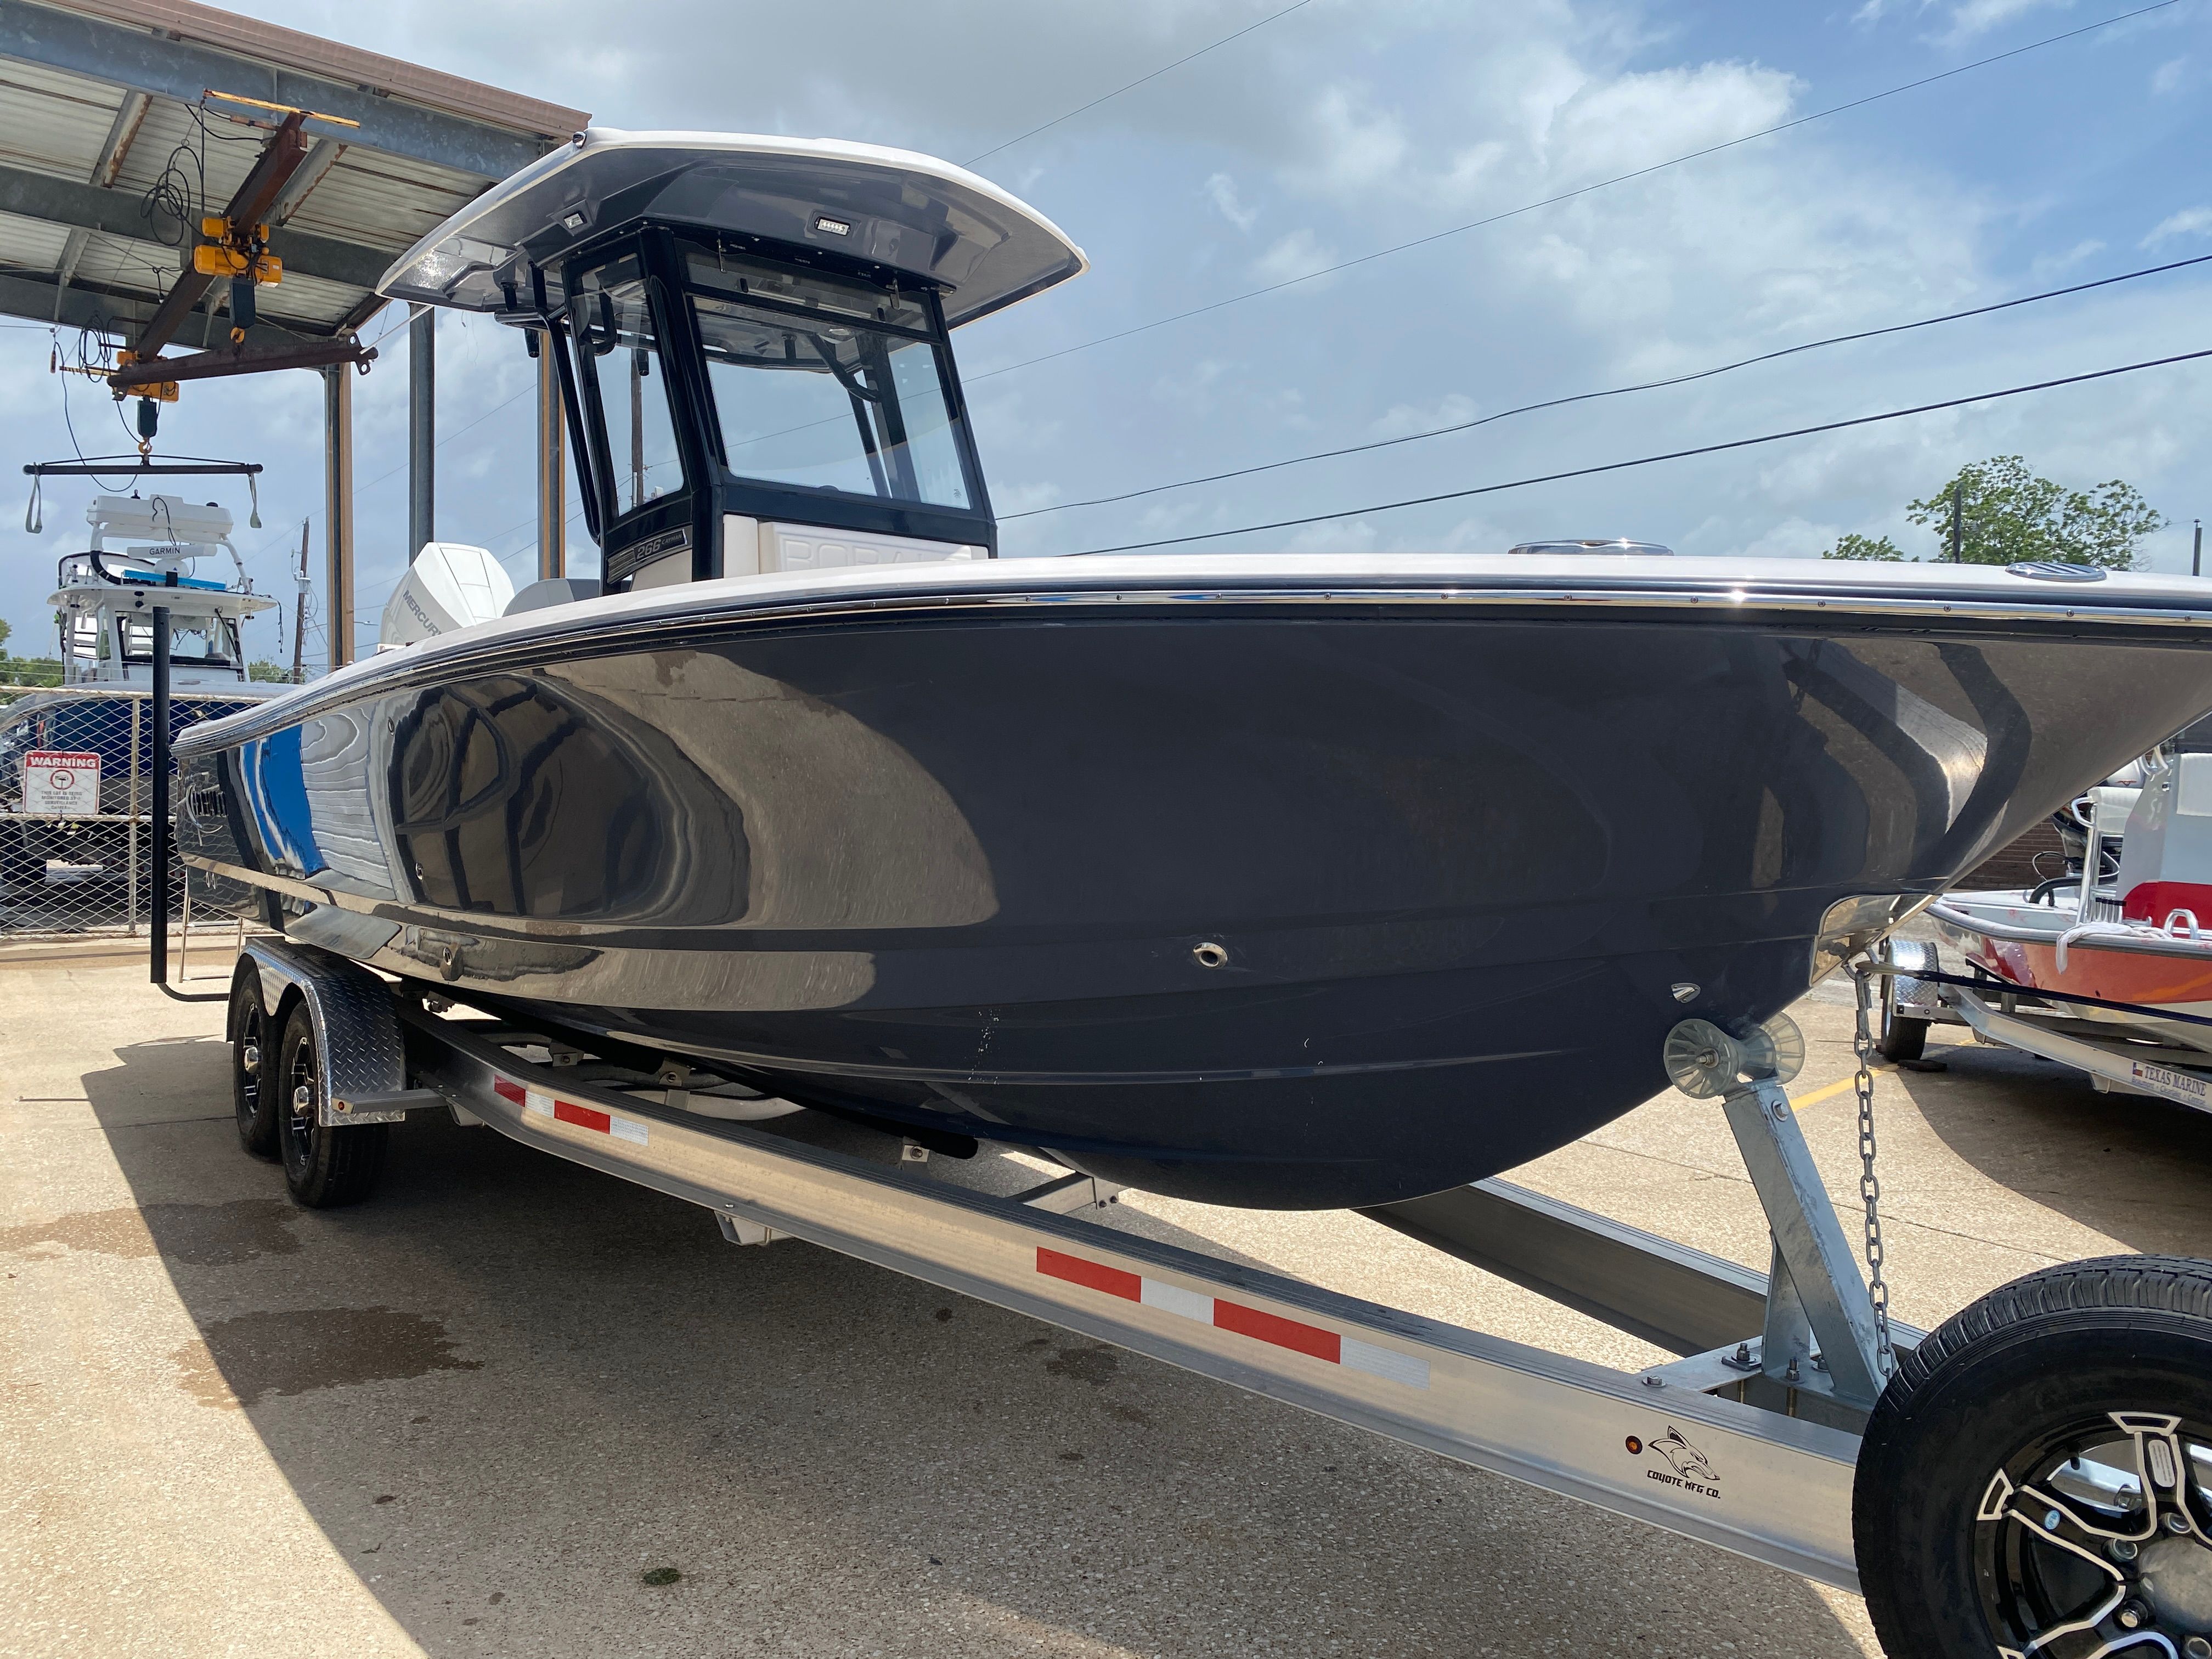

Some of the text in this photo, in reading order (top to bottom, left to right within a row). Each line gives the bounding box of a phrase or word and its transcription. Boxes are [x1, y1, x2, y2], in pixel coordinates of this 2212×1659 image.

[149, 547, 180, 555] GARMIN
[636, 534, 682, 560] 266 CAYMAN
[30, 757, 97, 768] WARNING
[2145, 1066, 2171, 1085] TEXAS
[2172, 1074, 2207, 1096] MARINE
[1647, 1470, 1721, 1499] COYOTE MFG CO.
